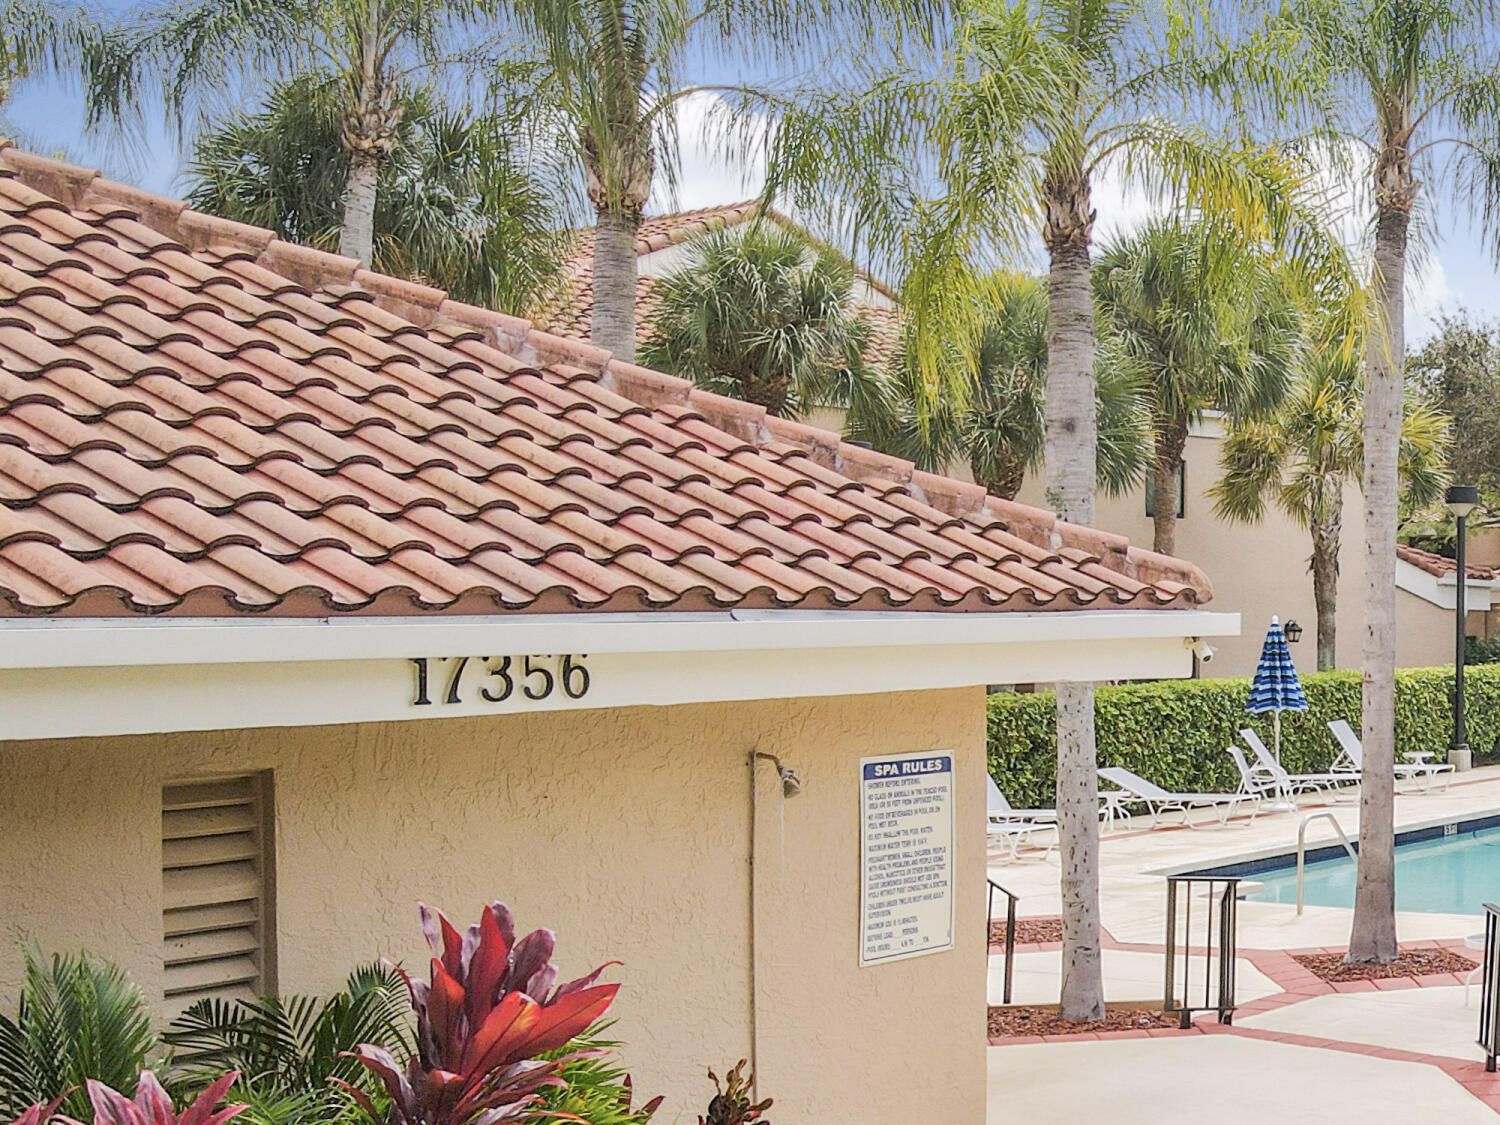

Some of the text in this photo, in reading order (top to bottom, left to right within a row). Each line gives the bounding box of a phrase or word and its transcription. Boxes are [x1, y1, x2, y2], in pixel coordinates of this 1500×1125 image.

[413, 654, 590, 705] 17356
[874, 759, 943, 777] SPA RULES
